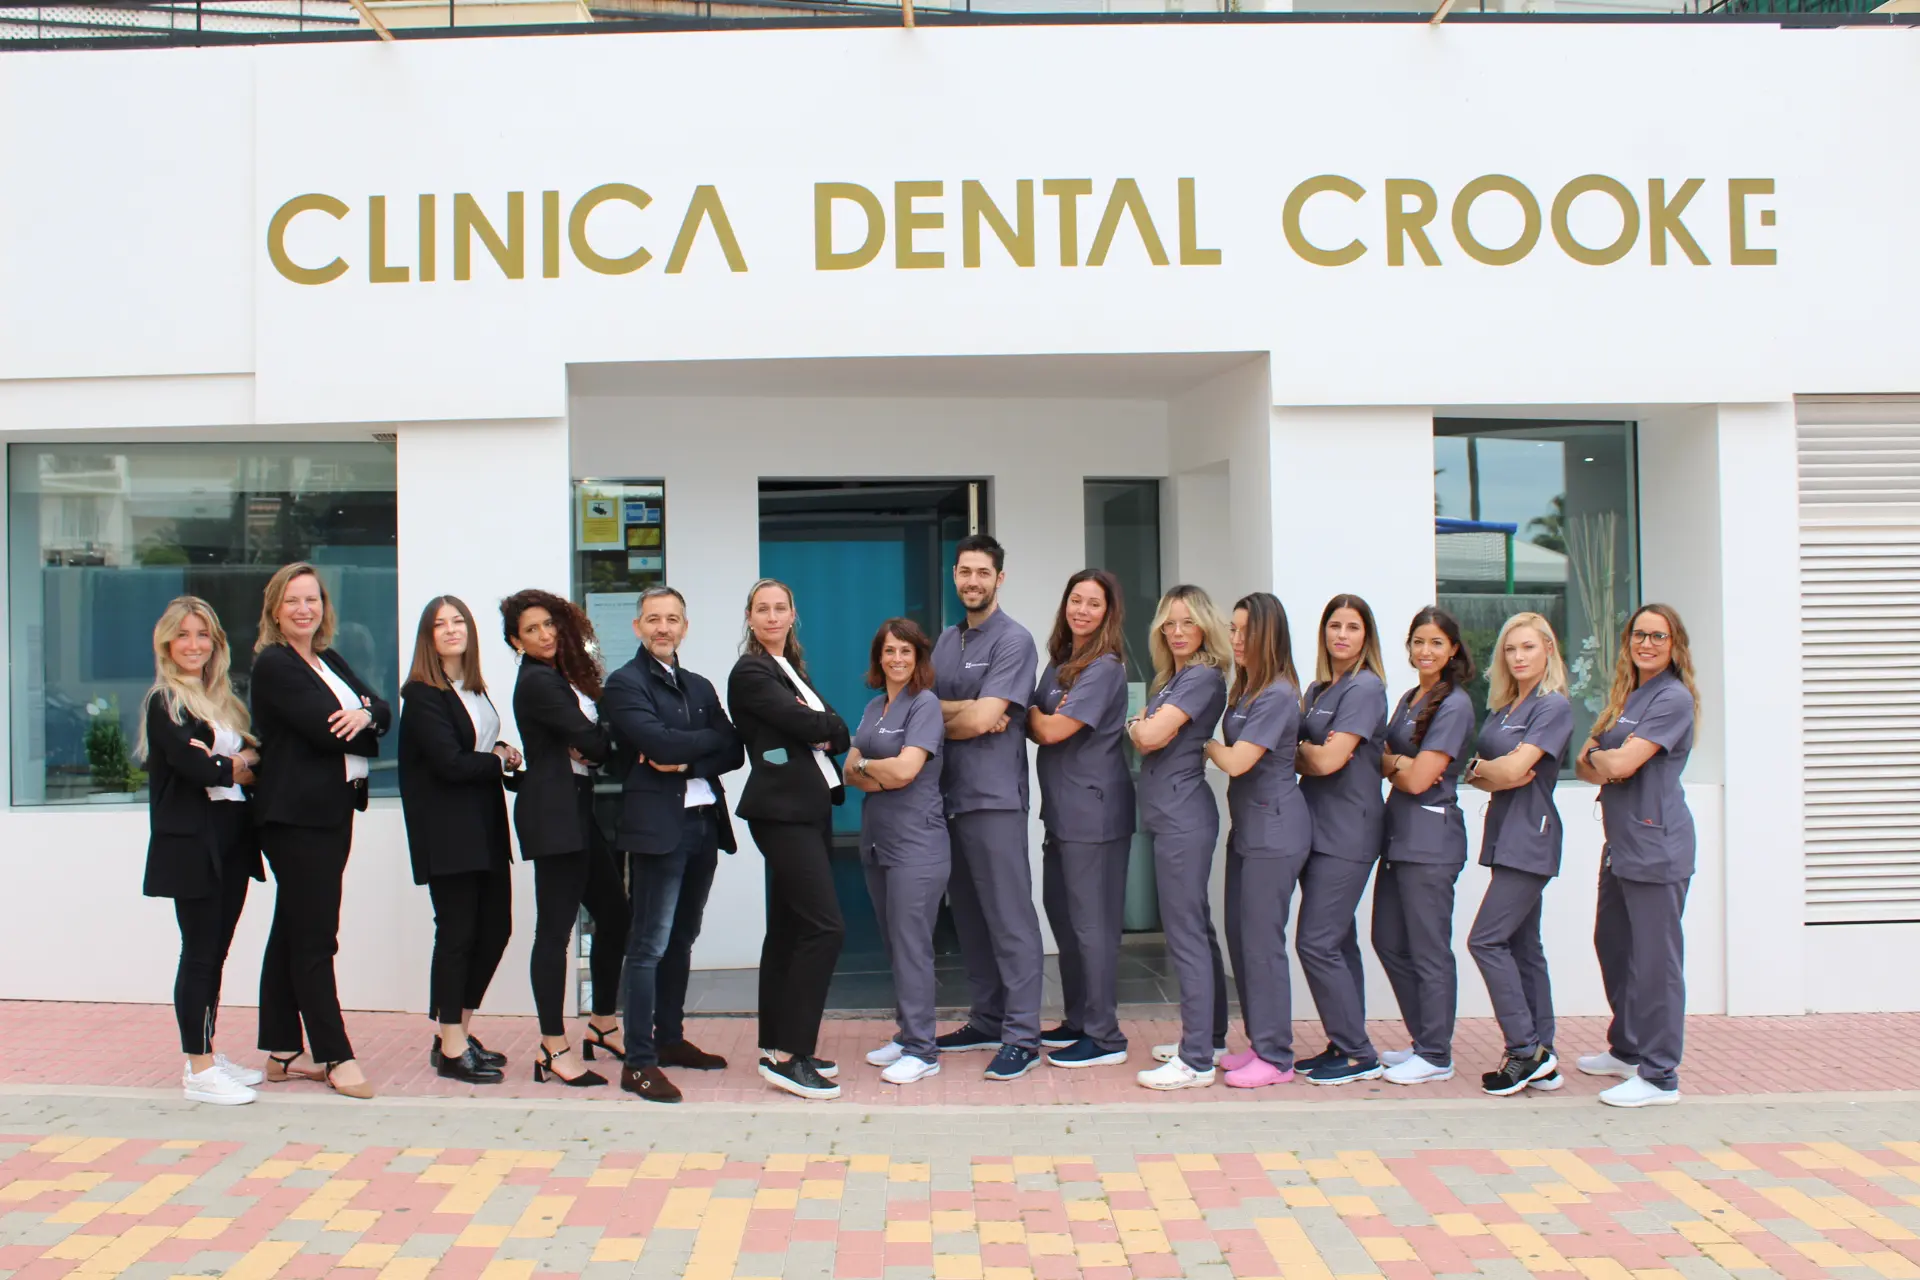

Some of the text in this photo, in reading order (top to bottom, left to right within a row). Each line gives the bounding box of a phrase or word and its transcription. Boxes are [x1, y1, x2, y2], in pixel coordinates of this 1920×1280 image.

[269, 176, 1776, 285] CLINICA DENTAL CROOKE
